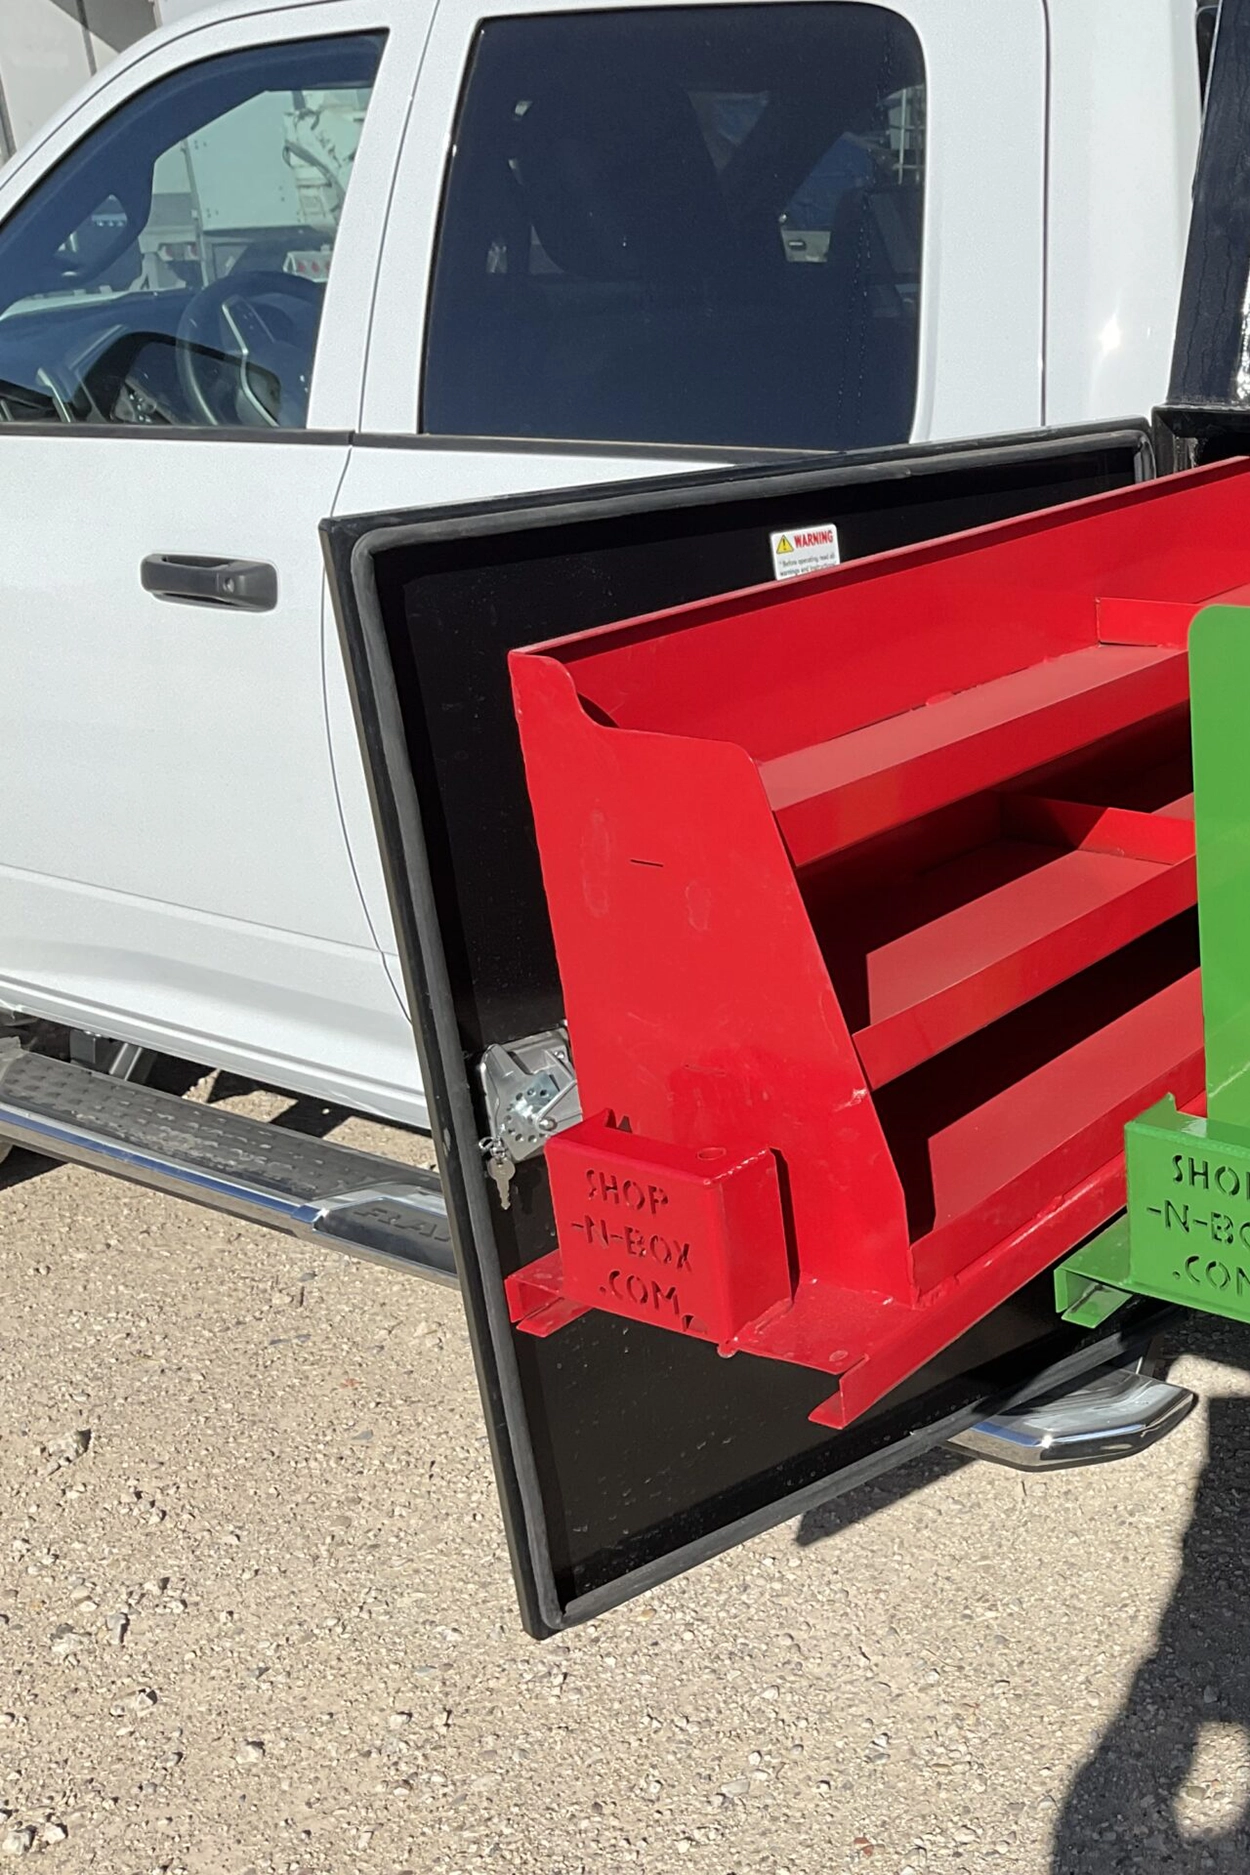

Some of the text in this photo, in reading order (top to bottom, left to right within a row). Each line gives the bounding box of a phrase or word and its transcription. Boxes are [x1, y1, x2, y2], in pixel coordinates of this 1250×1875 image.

[794, 530, 833, 548] WARNING
[585, 1169, 669, 1215] SHOP
[599, 1270, 680, 1315] .COM
